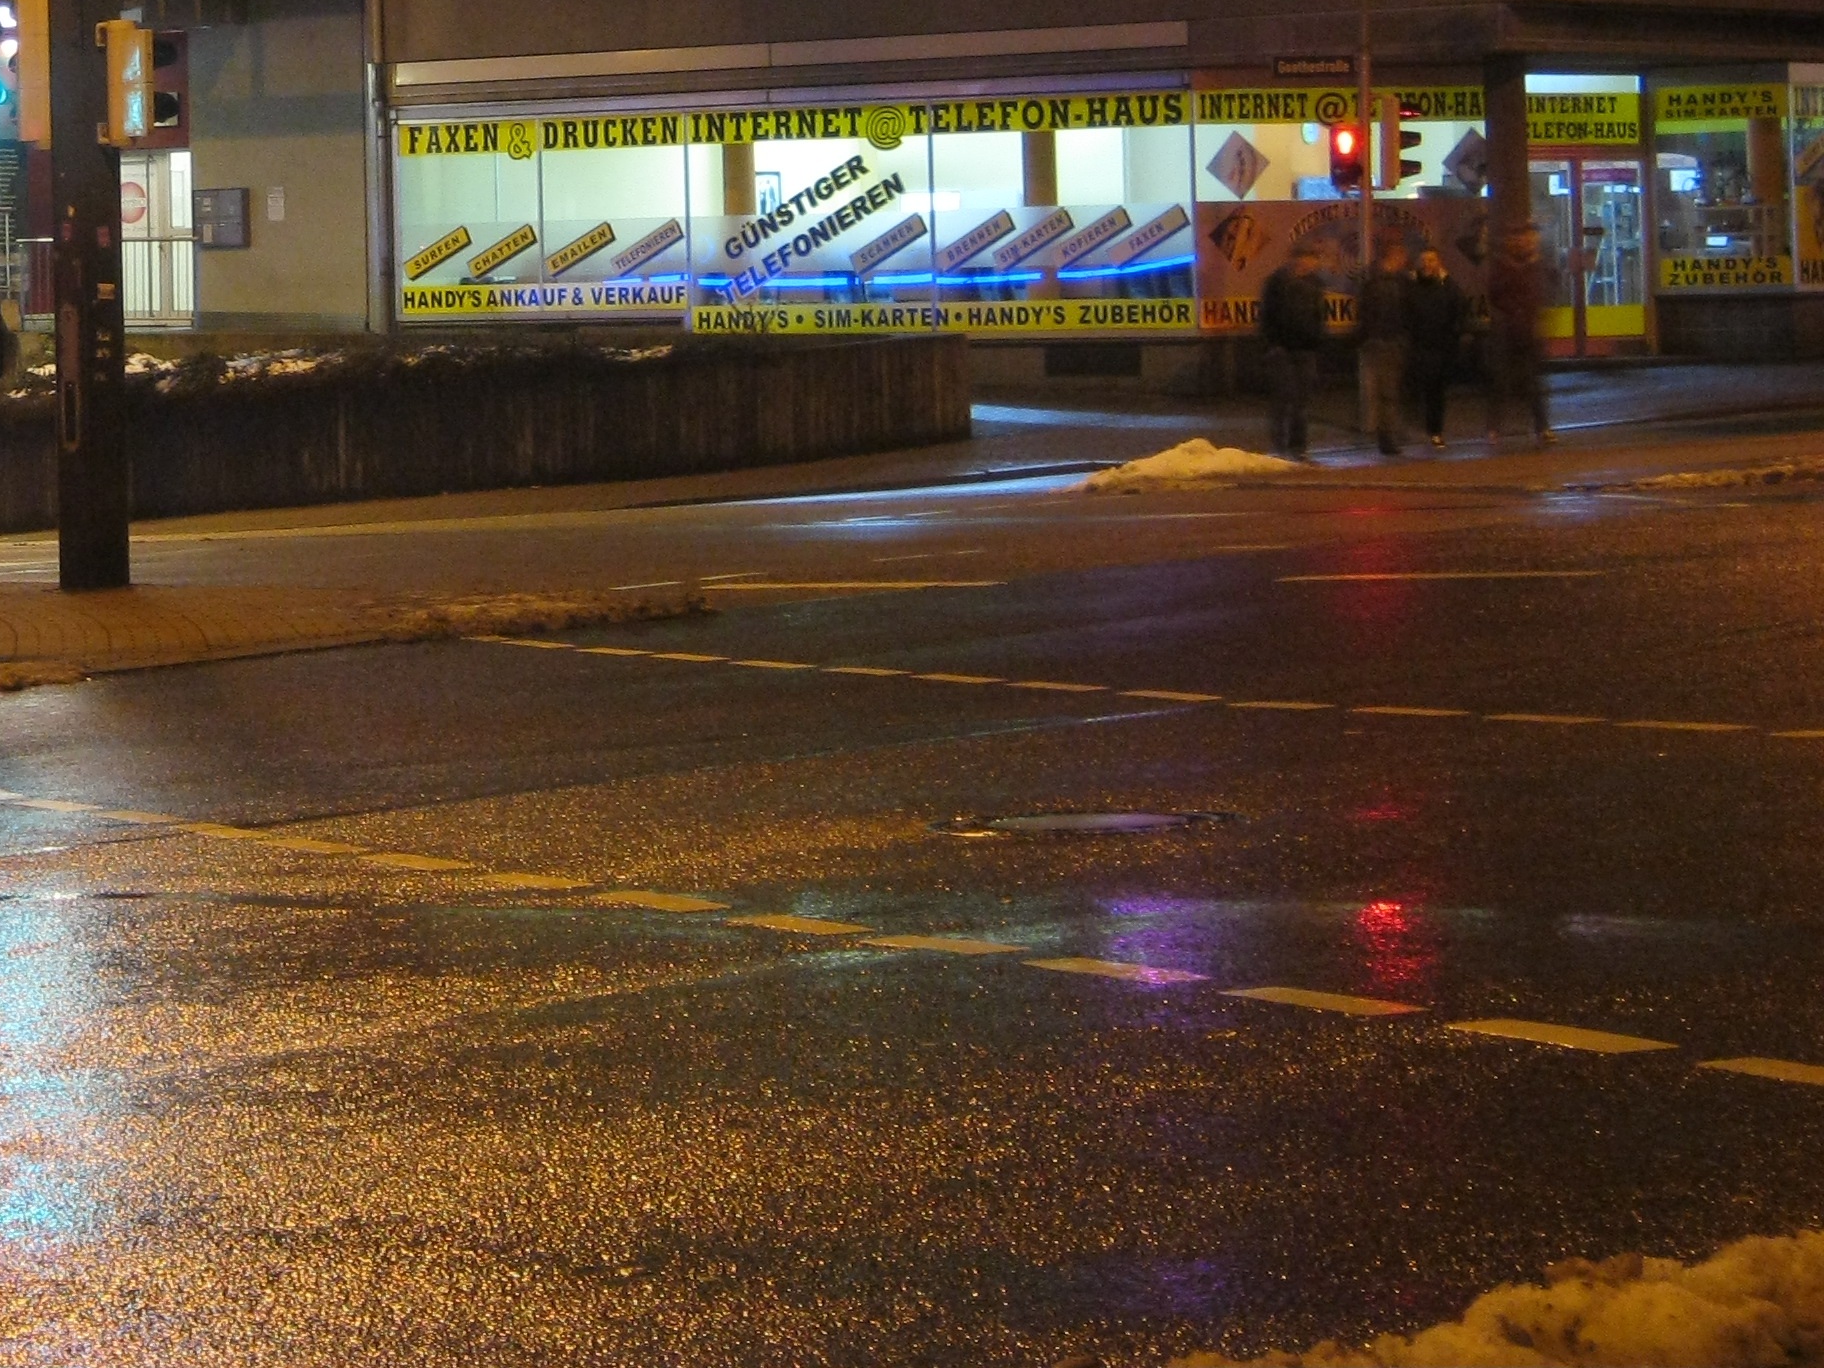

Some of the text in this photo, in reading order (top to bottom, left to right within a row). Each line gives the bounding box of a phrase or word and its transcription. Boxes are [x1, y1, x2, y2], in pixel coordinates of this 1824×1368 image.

[1200, 92, 1308, 119] INTERNET
[1527, 96, 1617, 113] INTERNET
[1668, 90, 1773, 106] HANDY'S
[408, 94, 1183, 160] FAXEN & DRUCKEN INTERNET @ TELEFON-HAUS
[1528, 122, 1638, 139] LEFON-HAUS
[725, 154, 871, 260] GÜNSTIGER
[413, 235, 462, 271] SURFEN
[474, 231, 530, 272] CHATTEN
[550, 229, 609, 270] EMAILEN
[613, 226, 678, 271] TELEFONIEREN
[717, 172, 906, 305] TELEFONIEREN
[860, 223, 914, 264] SCANNEN
[946, 217, 1002, 263] BRENNEN
[1061, 217, 1119, 259] KOPIEREN
[1128, 222, 1165, 251] FAXEN
[1669, 270, 1783, 286] ZUBEHÖR
[1673, 257, 1776, 271] HANDY'S
[403, 285, 686, 310] HANDY'S ANKAUF & VERKAUF
[698, 301, 1191, 330] HANDY'S SIM-KARTEN HANDY'S ZUBEHÖR
